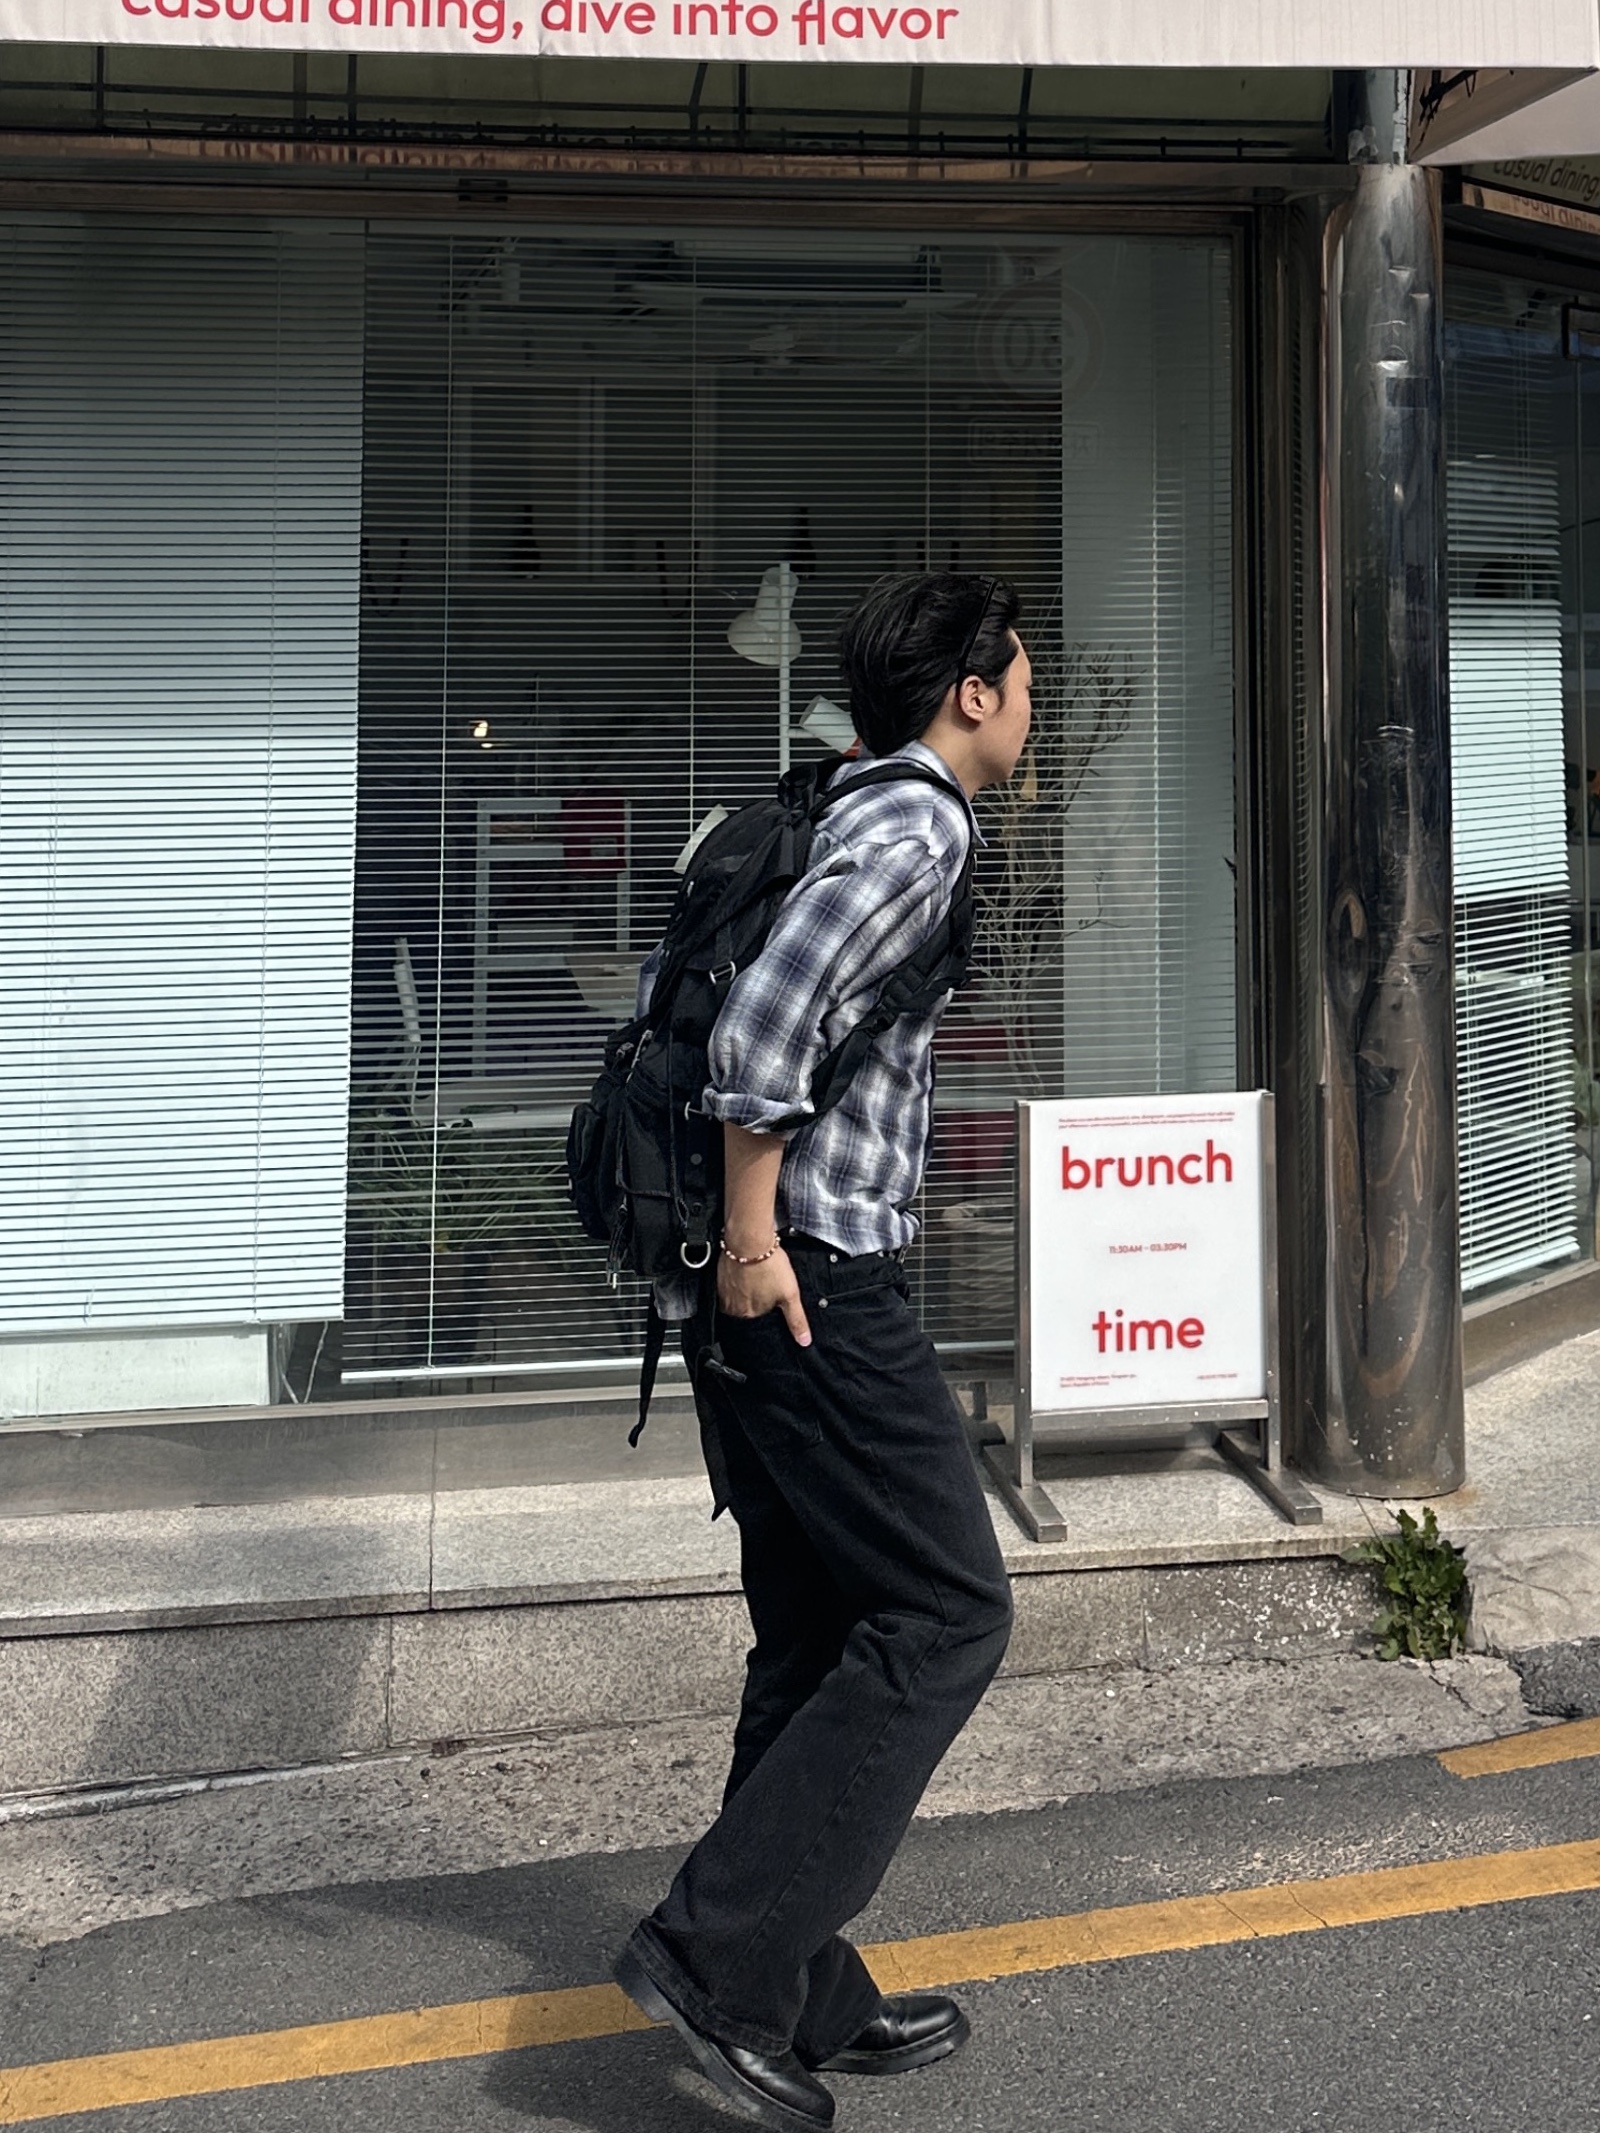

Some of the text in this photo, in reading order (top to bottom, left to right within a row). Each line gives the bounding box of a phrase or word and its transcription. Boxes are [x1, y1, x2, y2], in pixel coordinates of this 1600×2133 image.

[328, 0, 523, 44] dining,
[541, 0, 656, 35] dive
[673, 0, 779, 36] into
[792, 0, 959, 46] flavor
[1062, 1139, 1233, 1190] brunch
[1092, 1309, 1205, 1353] time
